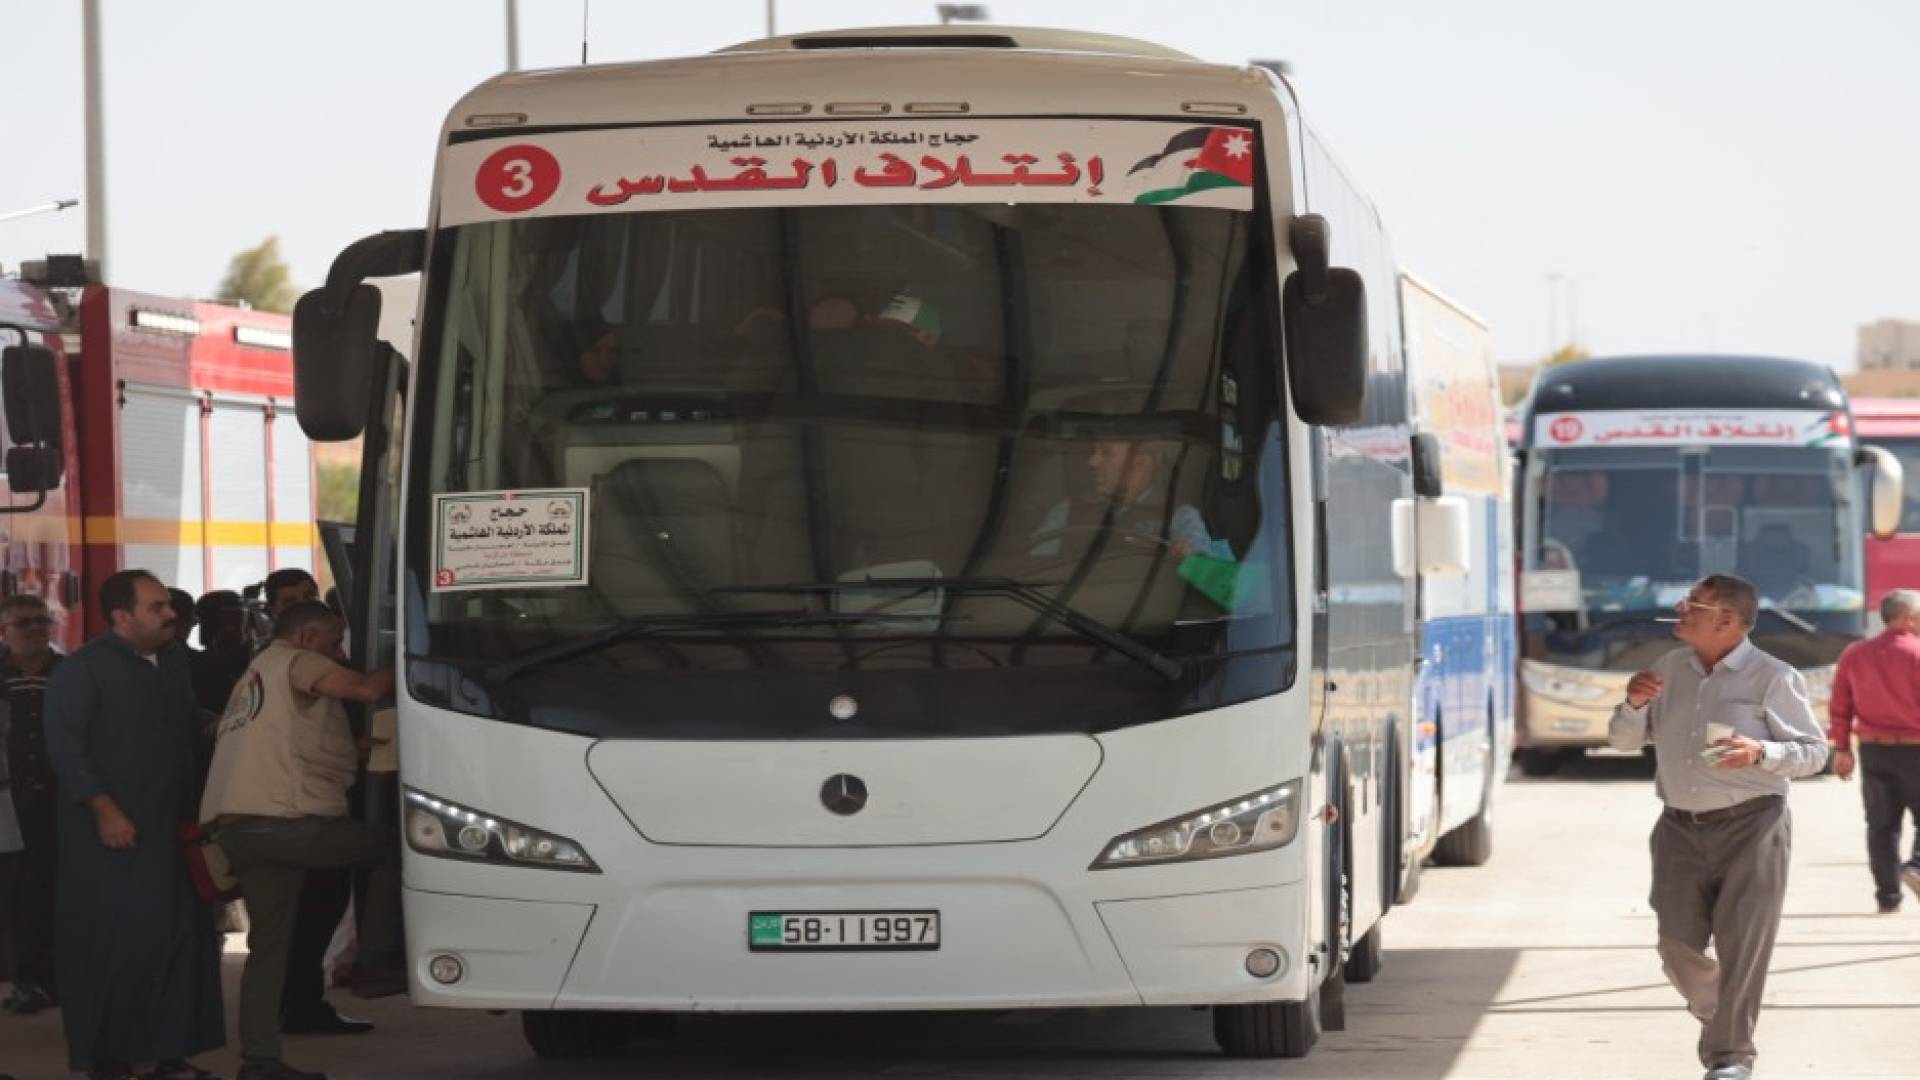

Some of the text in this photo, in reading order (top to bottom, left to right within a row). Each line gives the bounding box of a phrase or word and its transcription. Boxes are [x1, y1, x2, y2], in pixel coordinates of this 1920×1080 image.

[707, 132, 791, 151] الهاشمية
[869, 131, 925, 145] المملكة
[928, 133, 980, 147] حجاج
[501, 159, 533, 198] 3
[585, 156, 838, 206] القدس
